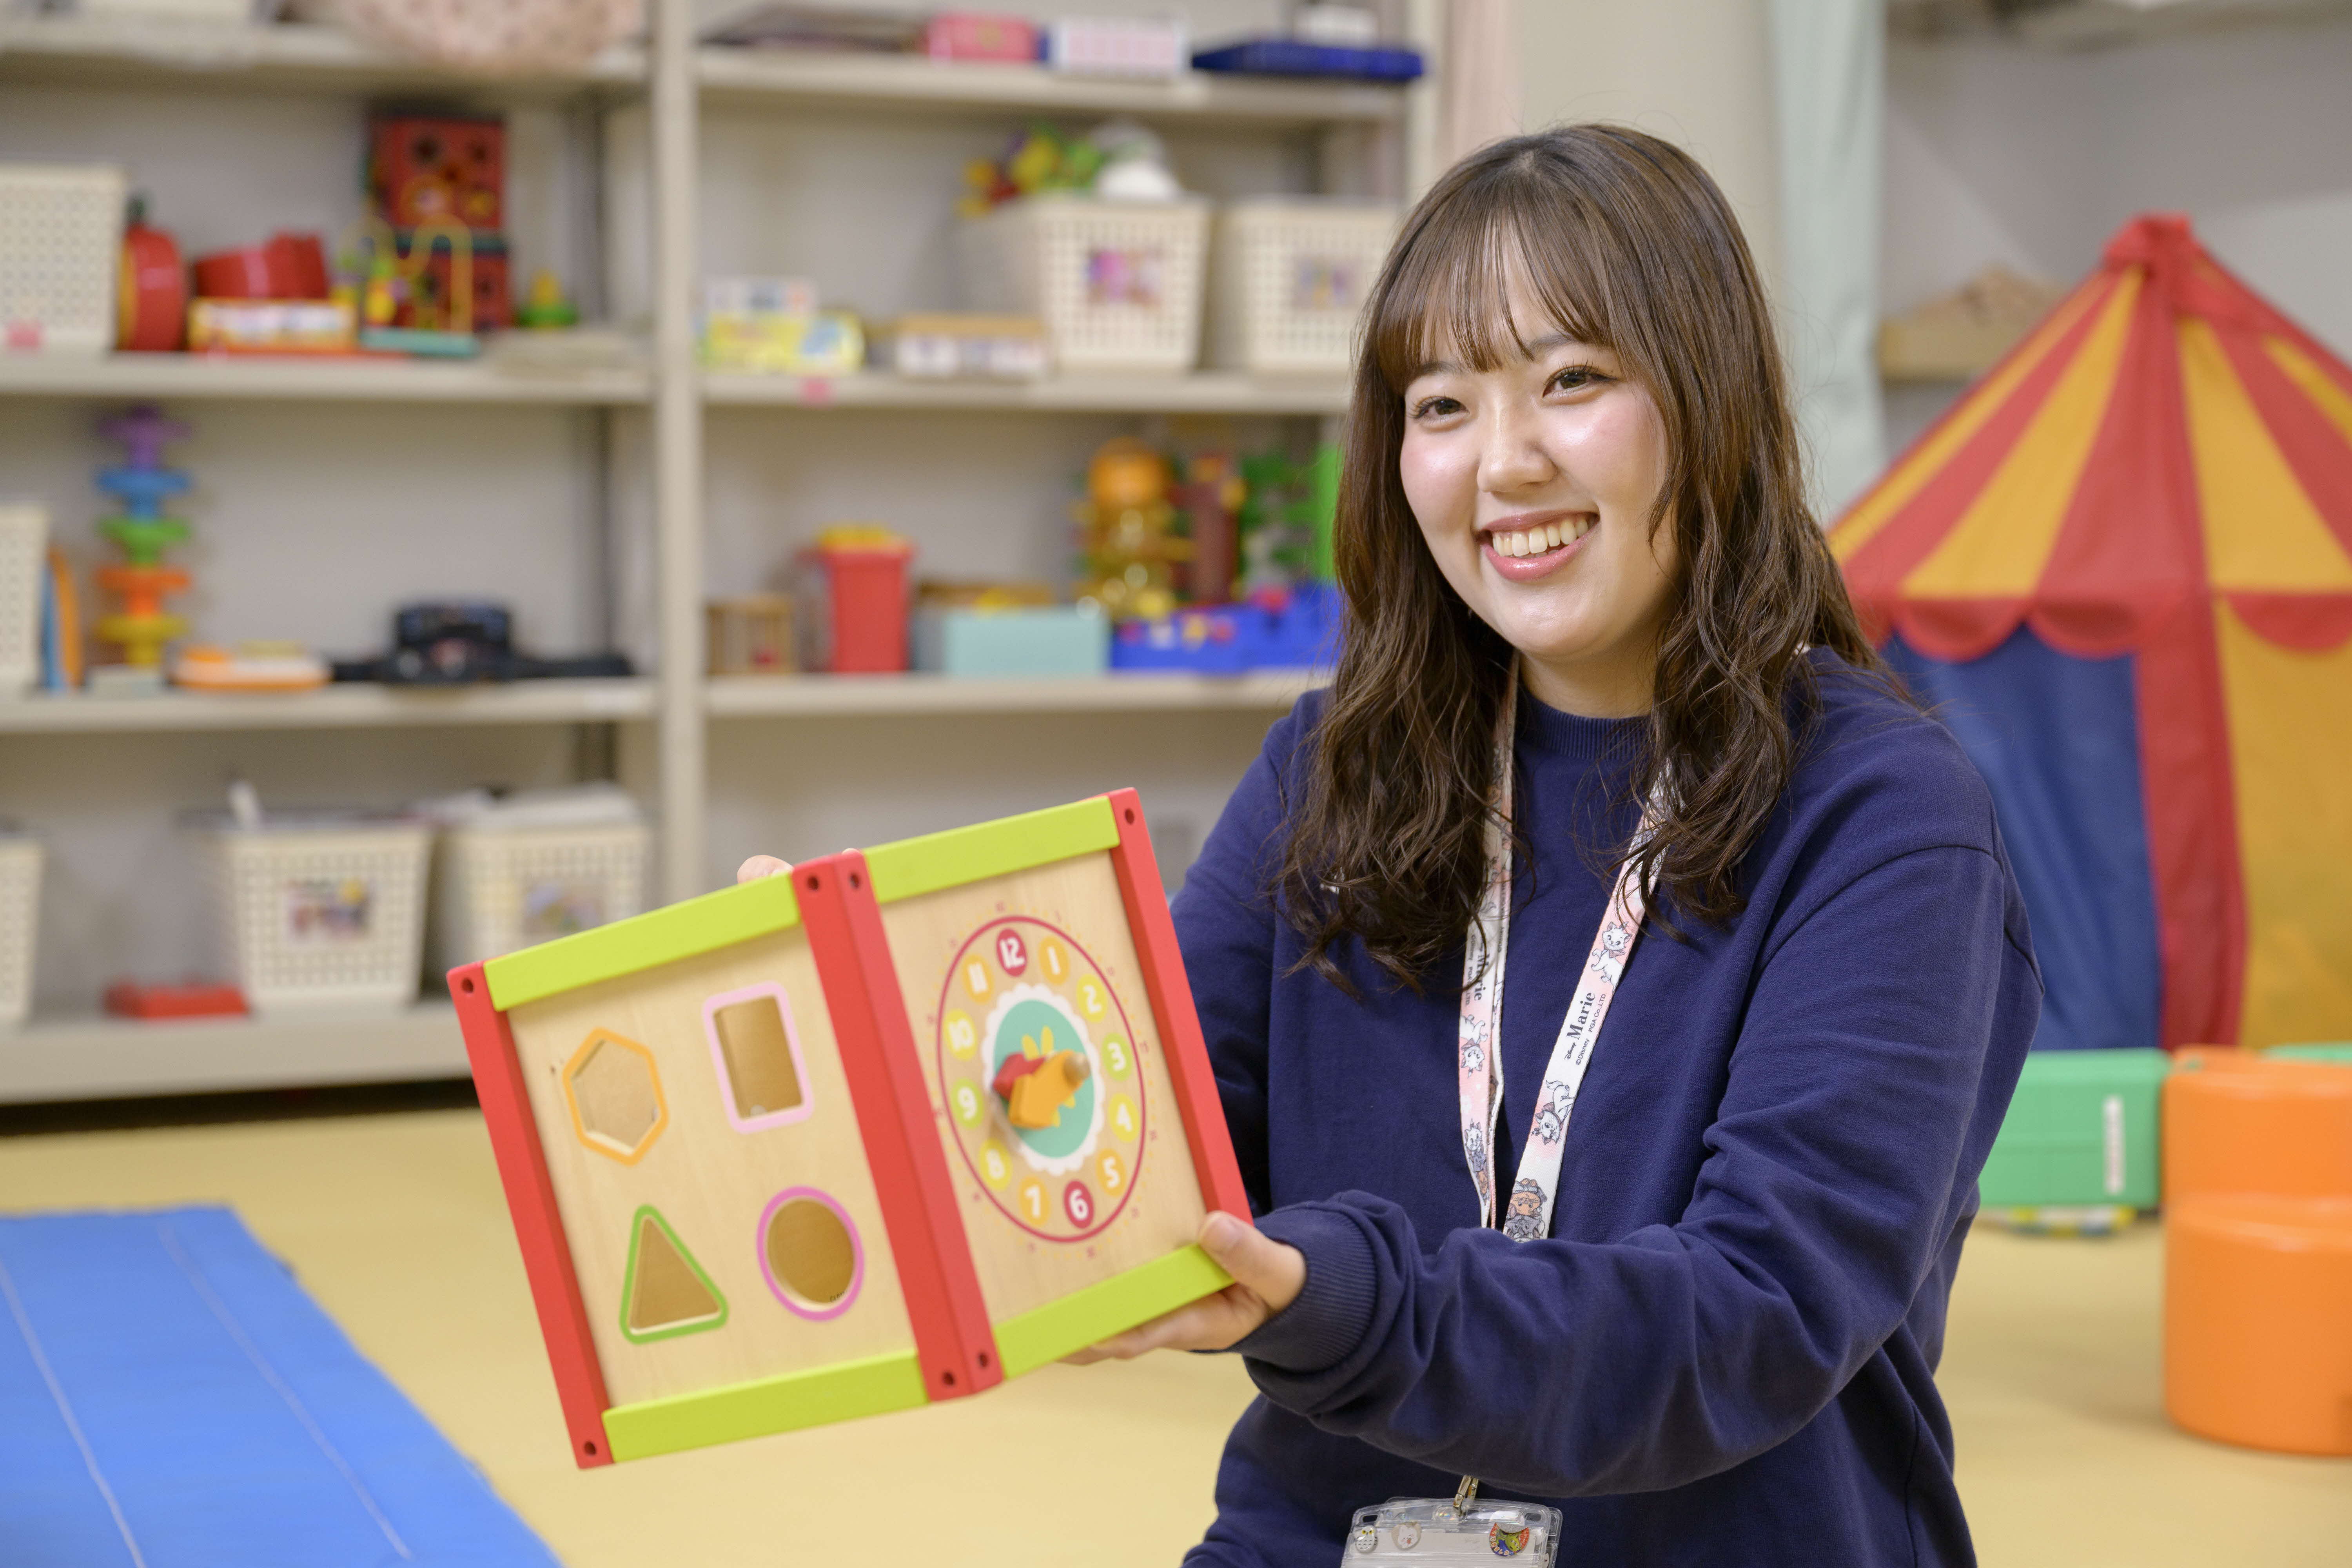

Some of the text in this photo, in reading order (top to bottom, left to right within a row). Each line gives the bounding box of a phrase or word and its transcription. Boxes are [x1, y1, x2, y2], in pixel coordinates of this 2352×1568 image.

[1000, 936, 1025, 968] 12
[1047, 946, 1061, 976] 1
[967, 962, 988, 995] 11
[1083, 984, 1102, 1015] 2
[1566, 992, 1595, 1040] Marie
[1588, 1019, 1596, 1032] PGA
[947, 1018, 974, 1051] 10
[1107, 1042, 1126, 1071] 3
[957, 1086, 978, 1120] 9
[1115, 1102, 1133, 1132] 4
[985, 1148, 1006, 1180] 8
[1102, 1156, 1120, 1189] 5
[1024, 1184, 1042, 1218] 7
[1069, 1189, 1089, 1221] 6
